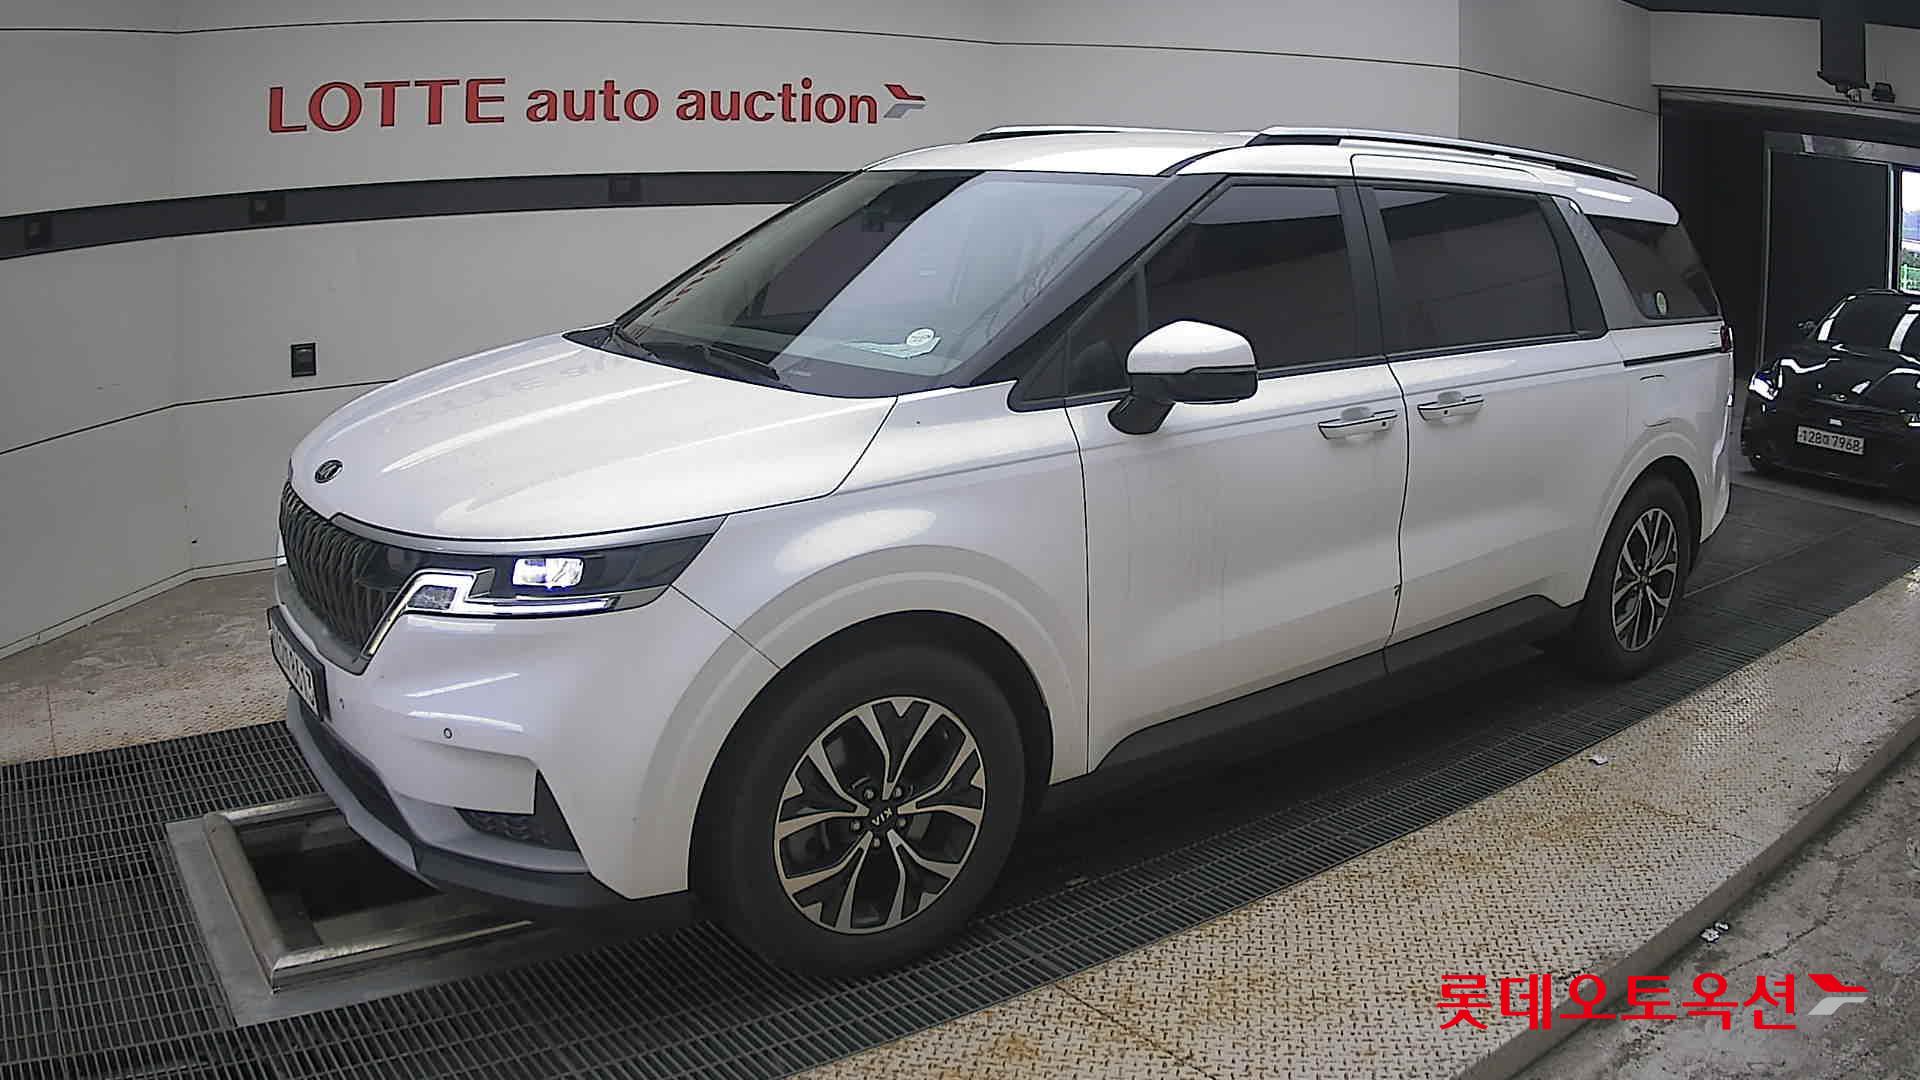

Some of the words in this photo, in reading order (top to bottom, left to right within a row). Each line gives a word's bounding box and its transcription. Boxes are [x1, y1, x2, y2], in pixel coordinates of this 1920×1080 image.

[268, 78, 505, 133] LOTTE
[526, 80, 659, 122] auto
[676, 78, 879, 124] auction
